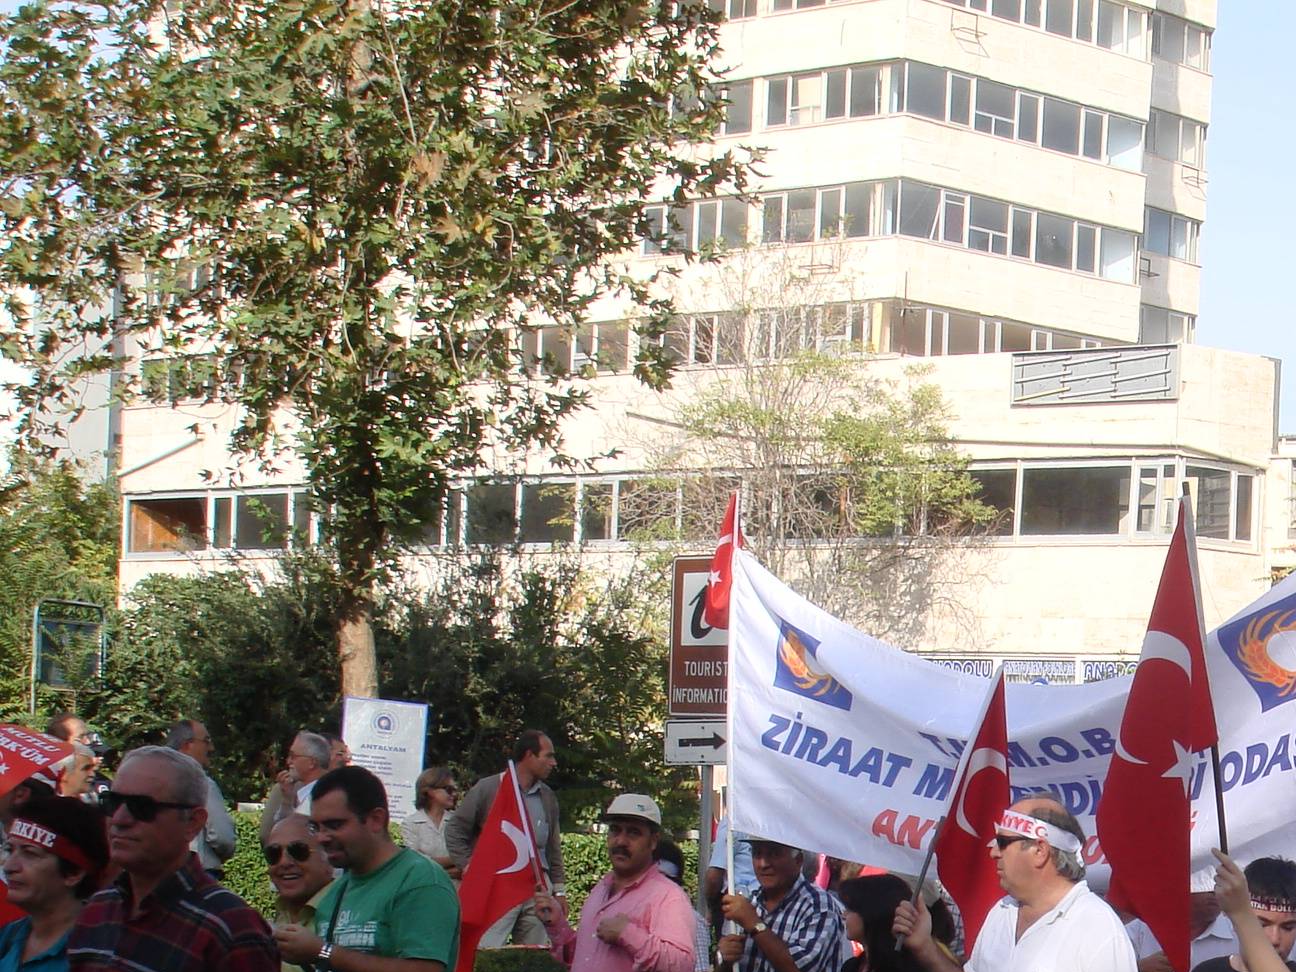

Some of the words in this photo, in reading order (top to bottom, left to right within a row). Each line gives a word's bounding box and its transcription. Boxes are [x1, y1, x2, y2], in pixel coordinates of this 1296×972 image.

[684, 661, 728, 677] TOURIST
[1083, 661, 1138, 680] ANADO
[672, 684, 728, 704] İNFORMATIO
[761, 711, 912, 788] ZİRAAT
[9, 820, 57, 847] RKİYE
